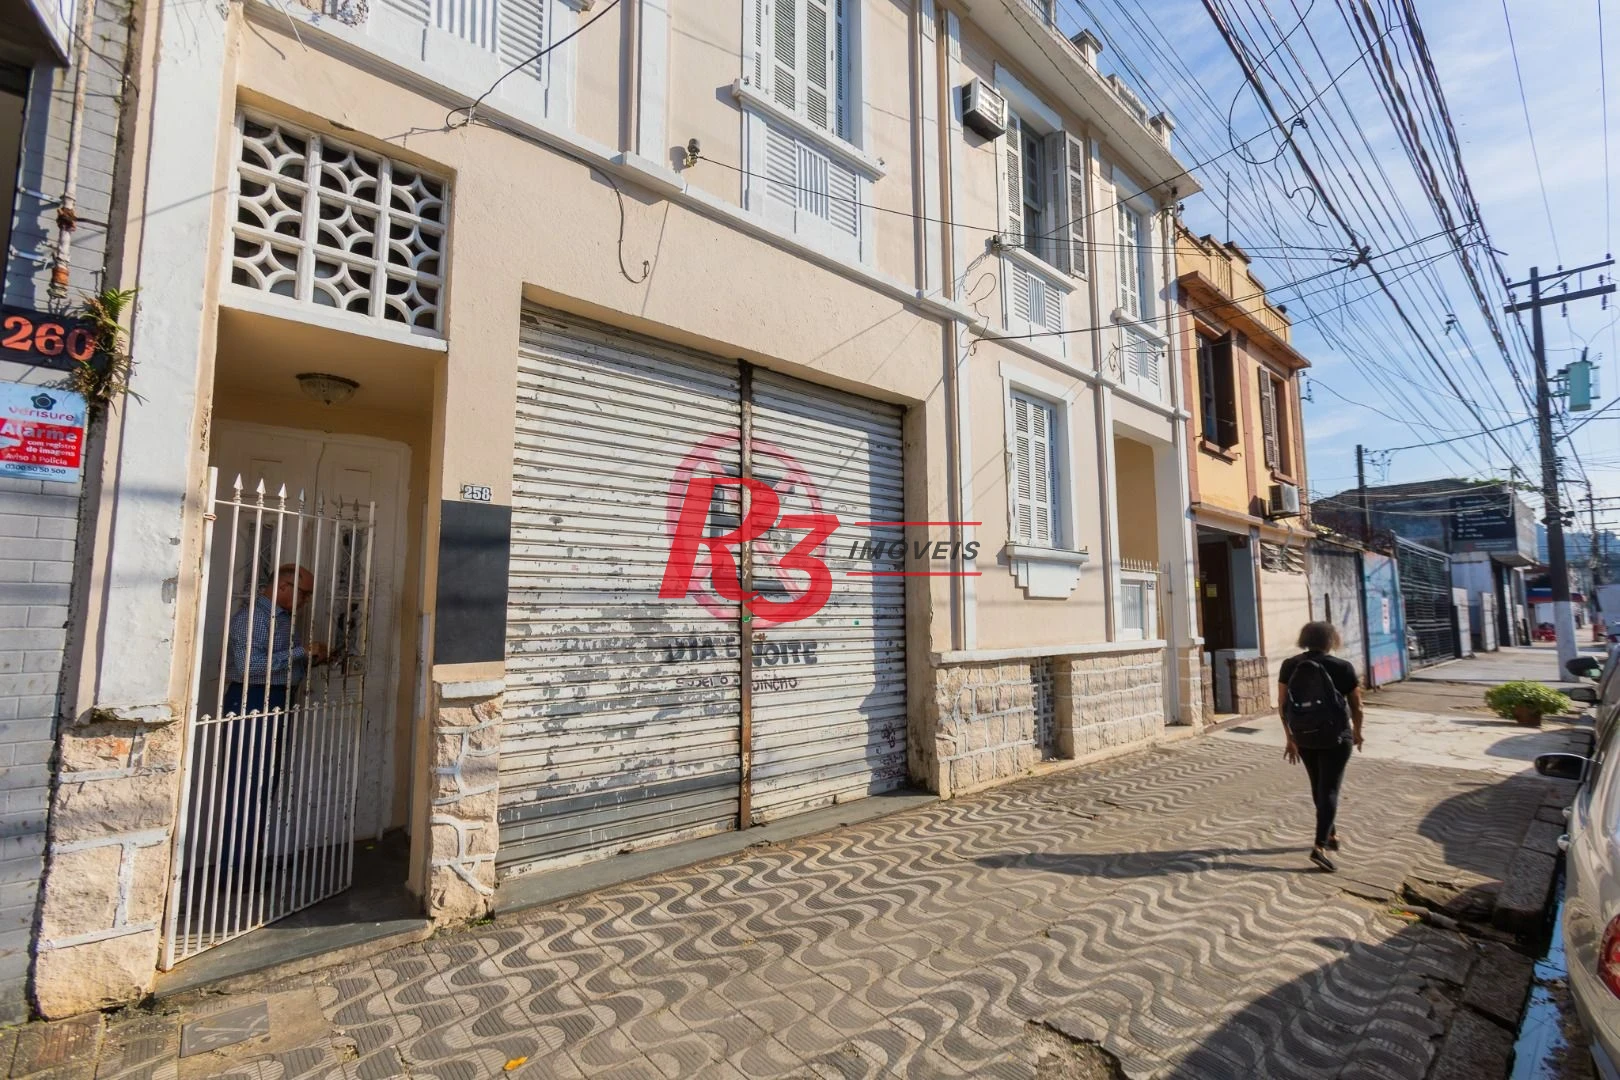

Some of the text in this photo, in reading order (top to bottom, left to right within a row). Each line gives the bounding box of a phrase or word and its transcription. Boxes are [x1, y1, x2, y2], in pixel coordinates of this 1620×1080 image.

[2, 315, 95, 362] 260
[0, 421, 78, 443] Alarme
[40, 447, 75, 457] imagens
[46, 442, 76, 450] registro
[5, 452, 29, 461] Aviso
[464, 486, 490, 501] 258
